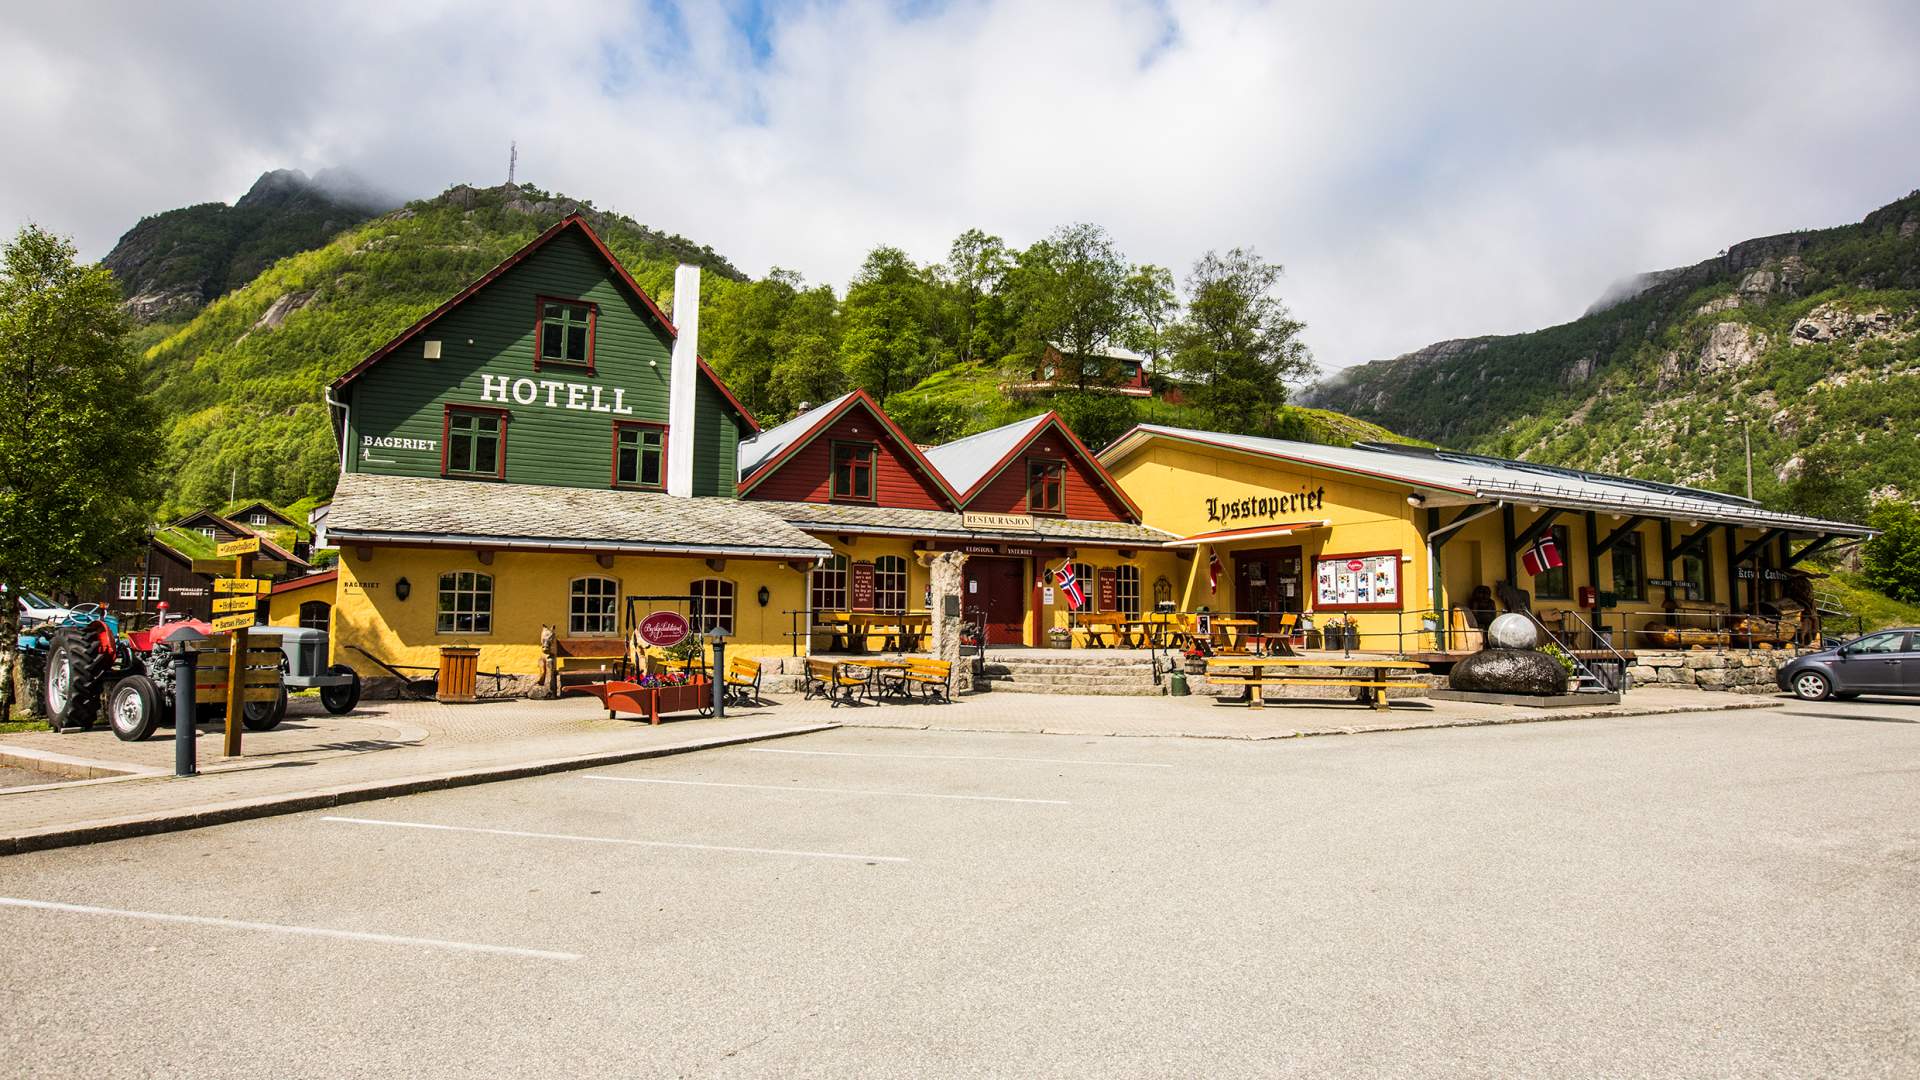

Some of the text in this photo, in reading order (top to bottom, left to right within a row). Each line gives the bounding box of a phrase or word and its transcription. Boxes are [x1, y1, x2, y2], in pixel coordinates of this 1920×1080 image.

[480, 374, 633, 415] HOTELL
[363, 435, 437, 451] BAGERIET
[1206, 485, 1325, 526] Lysstøperiet
[967, 515, 1030, 526] RESTAURASJON
